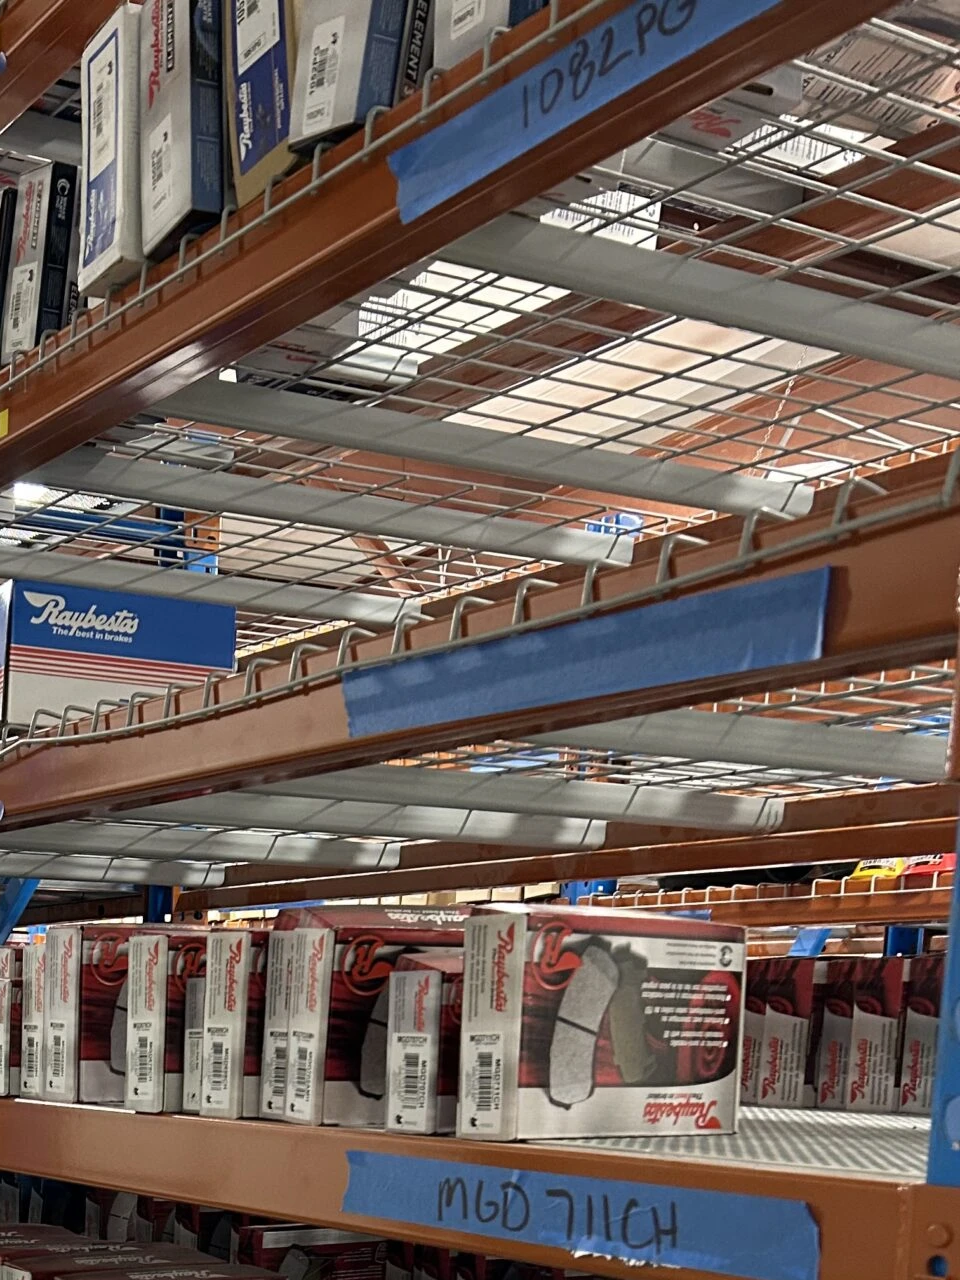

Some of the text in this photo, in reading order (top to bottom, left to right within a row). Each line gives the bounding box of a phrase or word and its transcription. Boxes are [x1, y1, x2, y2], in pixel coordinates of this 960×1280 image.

[405, 0, 428, 80] ELEMENT
[23, 591, 139, 638] Raybestos
[52, 626, 68, 635] The
[75, 629, 94, 639] best
[105, 632, 133, 644] brakes
[144, 940, 160, 1012] Raybestos
[224, 936, 244, 1012] Raybestos
[307, 935, 326, 1013] Raybestos
[496, 920, 515, 1014] Raybestos
[414, 975, 430, 1033] Raybestos
[493, 1058, 502, 1111] MGD711CH
[644, 1099, 722, 1131] Raybestos
[440, 1176, 678, 1255] MGD 711CH
